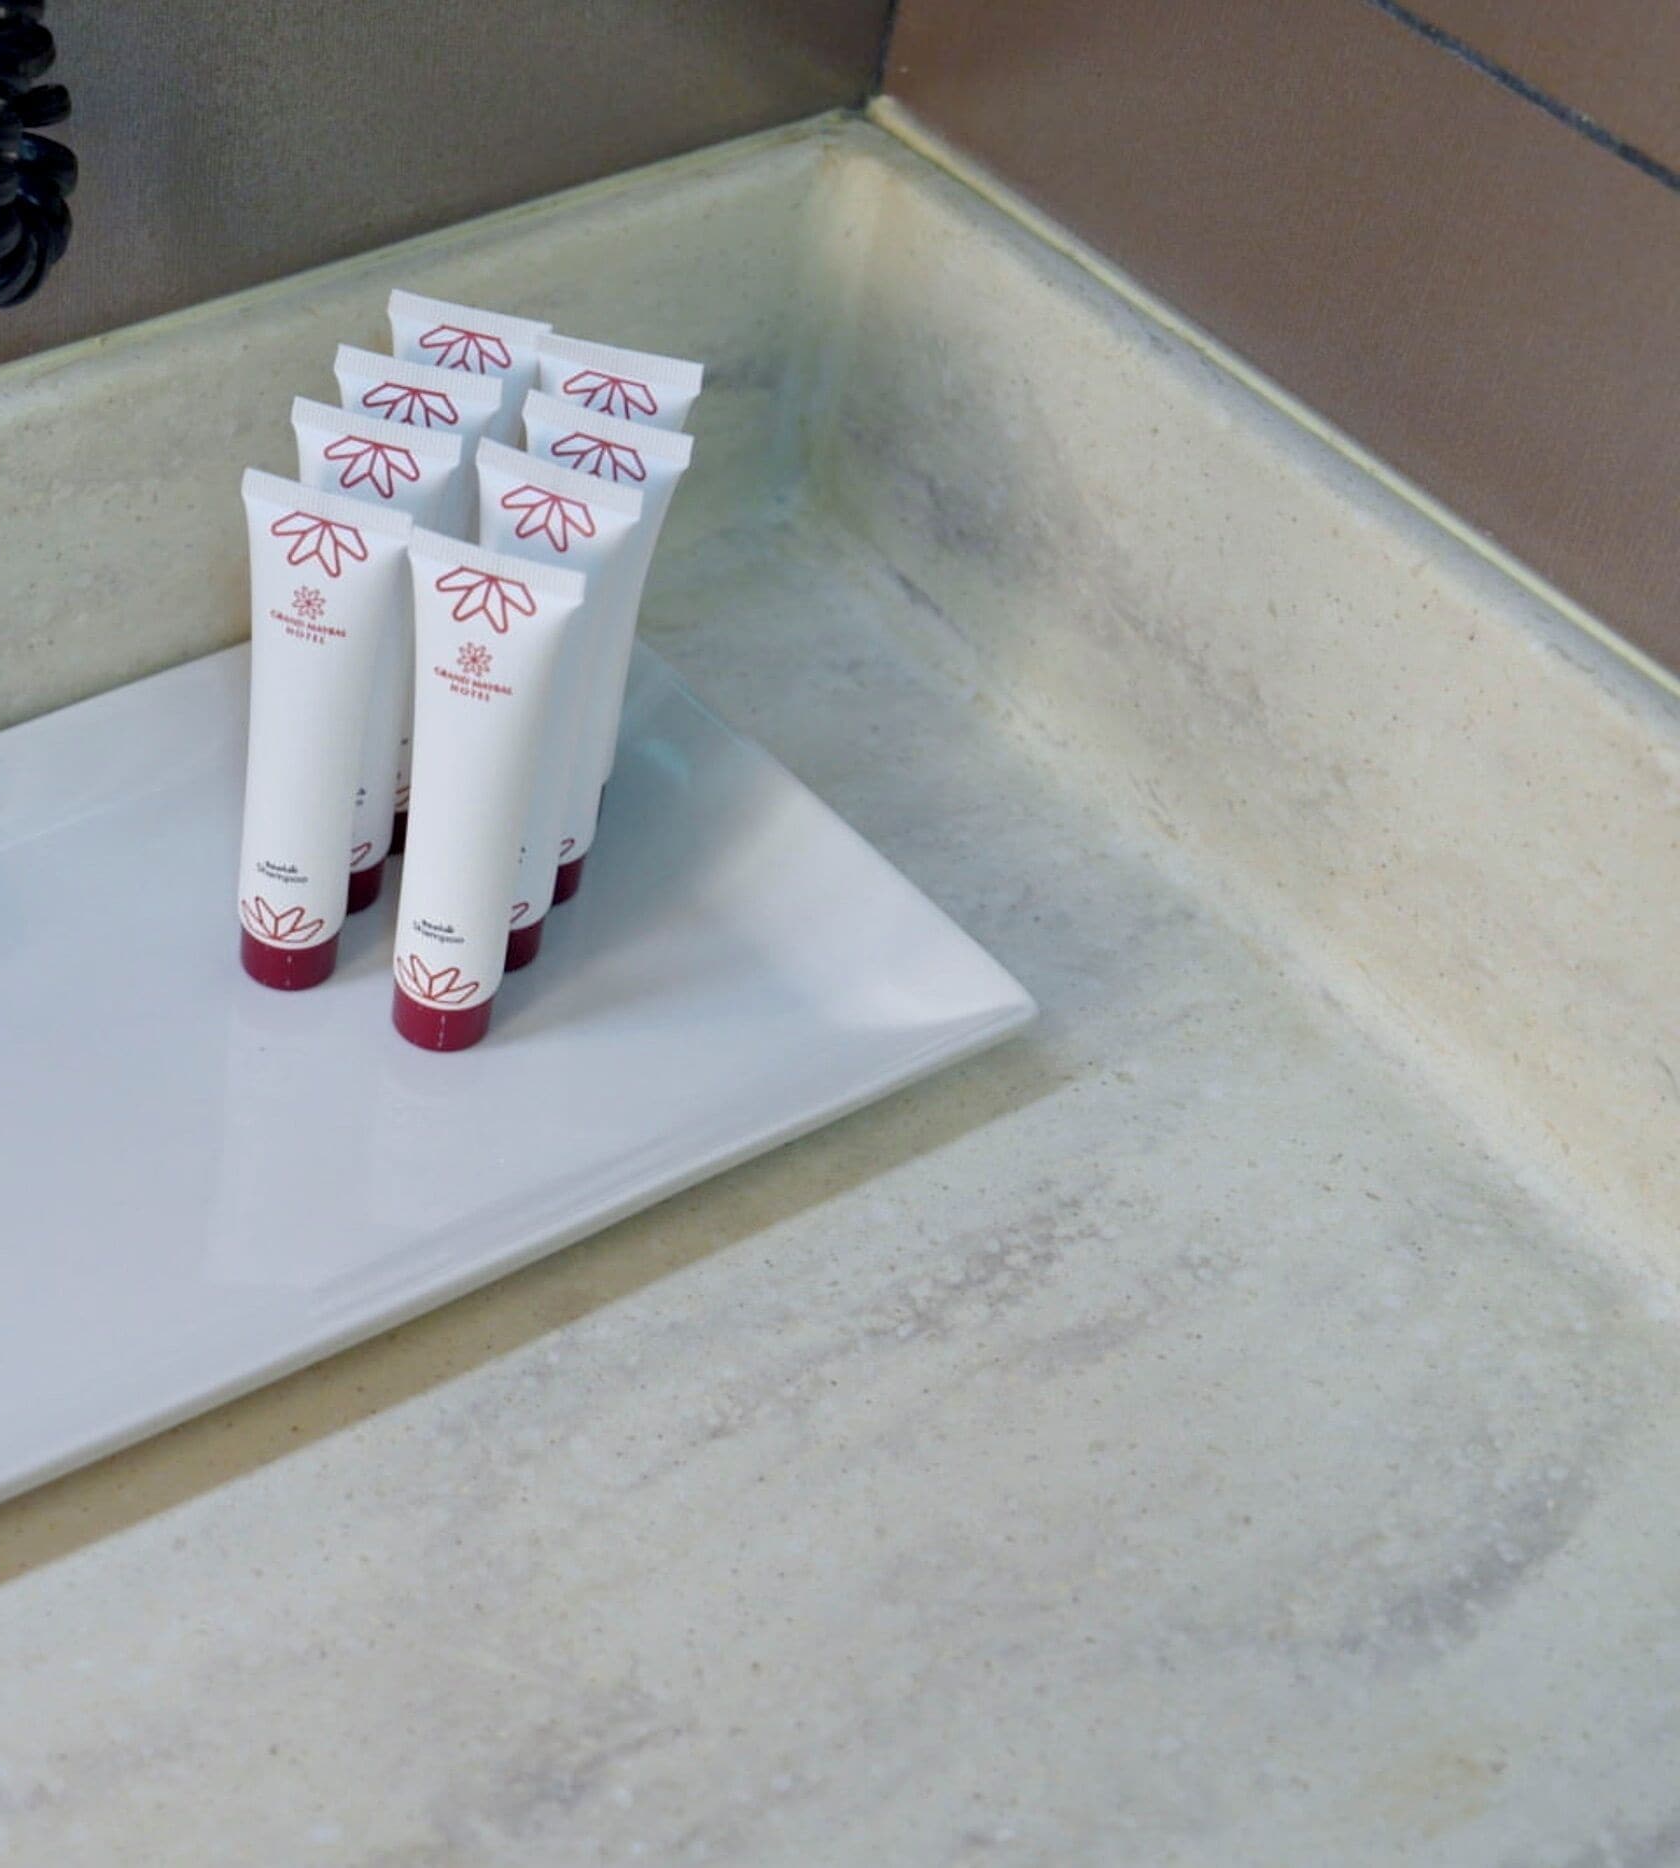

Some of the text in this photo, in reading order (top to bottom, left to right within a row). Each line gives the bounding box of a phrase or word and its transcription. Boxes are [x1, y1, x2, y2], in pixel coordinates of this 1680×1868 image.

[269, 609, 306, 627] GRAND
[285, 626, 325, 645] HOTEL
[433, 666, 470, 685] GRAND
[449, 683, 491, 702] HOTEL
